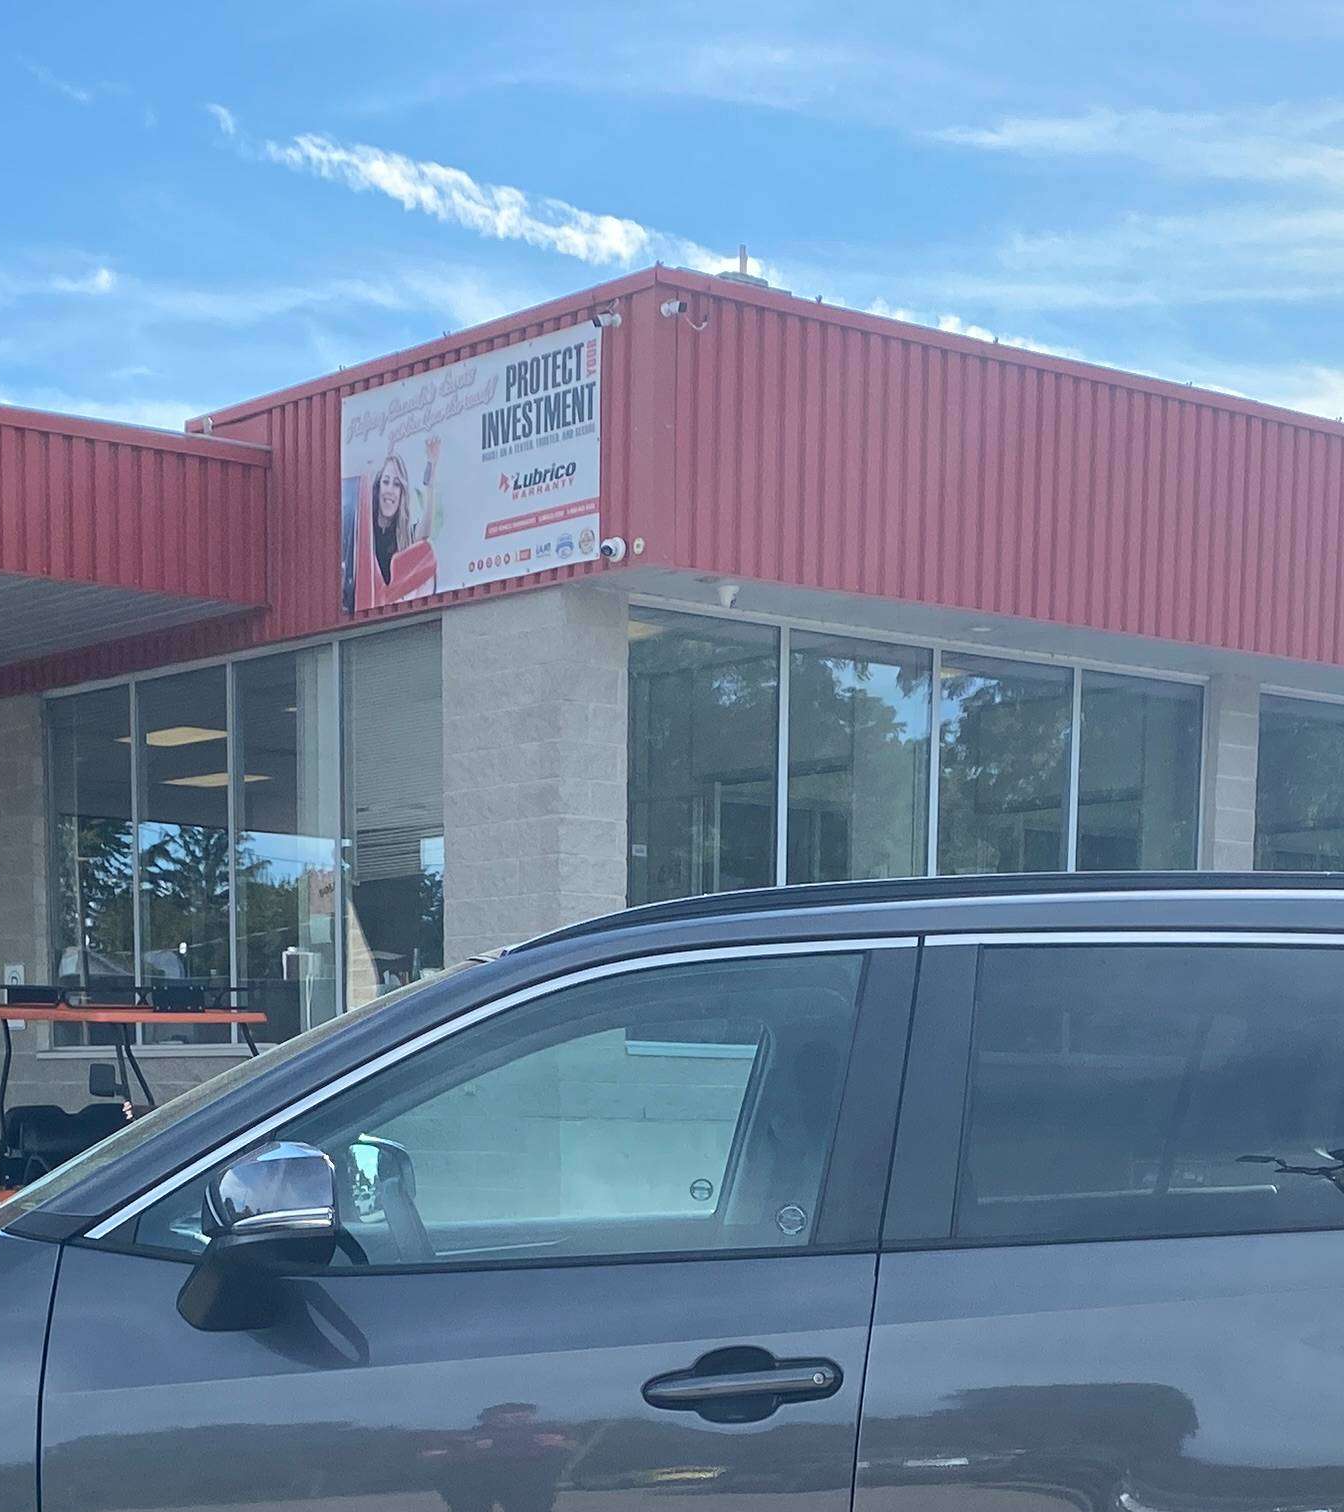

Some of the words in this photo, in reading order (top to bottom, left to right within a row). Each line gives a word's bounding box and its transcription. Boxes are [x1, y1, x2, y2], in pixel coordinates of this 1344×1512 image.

[505, 342, 585, 403] PROTECT
[481, 381, 596, 450] INVESTMENT
[512, 478, 575, 500] WARRANTY
[513, 462, 577, 490] Lubrico
